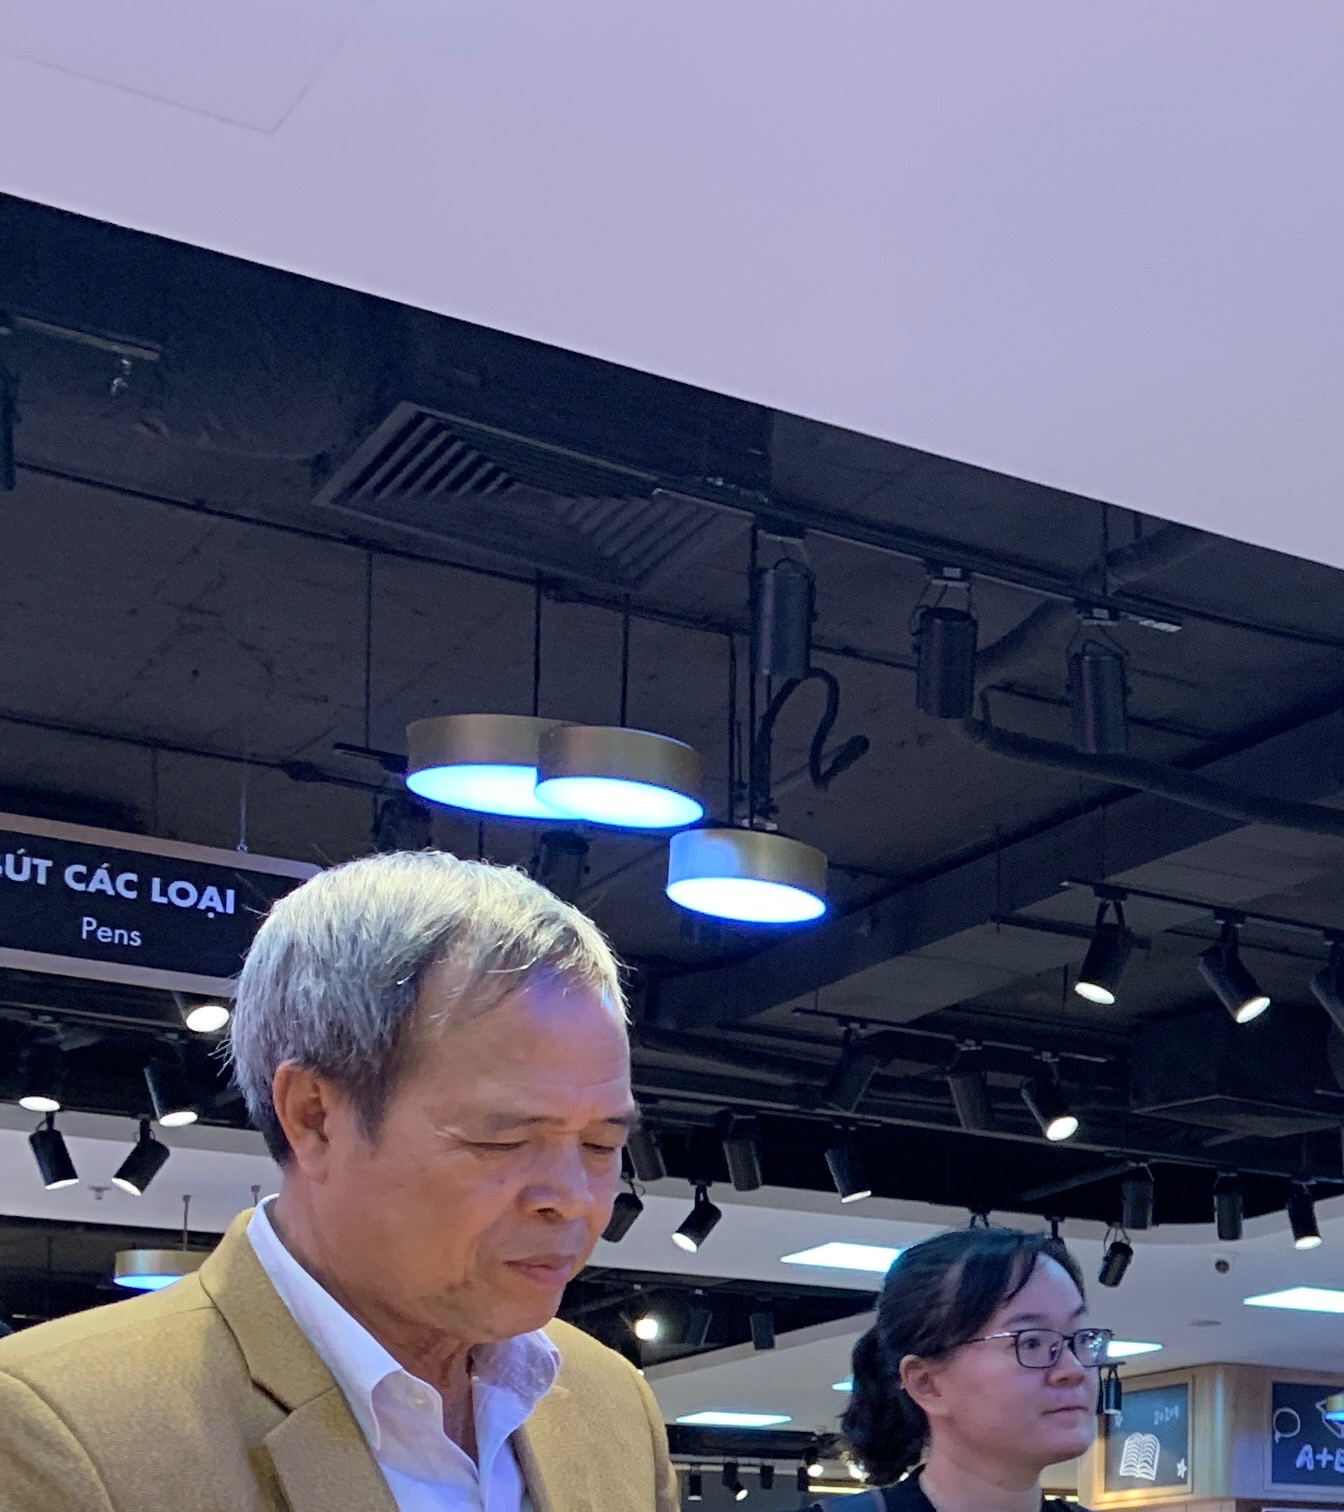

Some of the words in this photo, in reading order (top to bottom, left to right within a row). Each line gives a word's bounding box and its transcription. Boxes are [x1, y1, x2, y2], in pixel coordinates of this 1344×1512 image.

[0, 848, 53, 886] ÚT
[64, 862, 139, 899] CÁC
[151, 876, 235, 919] LOẠI
[81, 916, 142, 947] Pens
